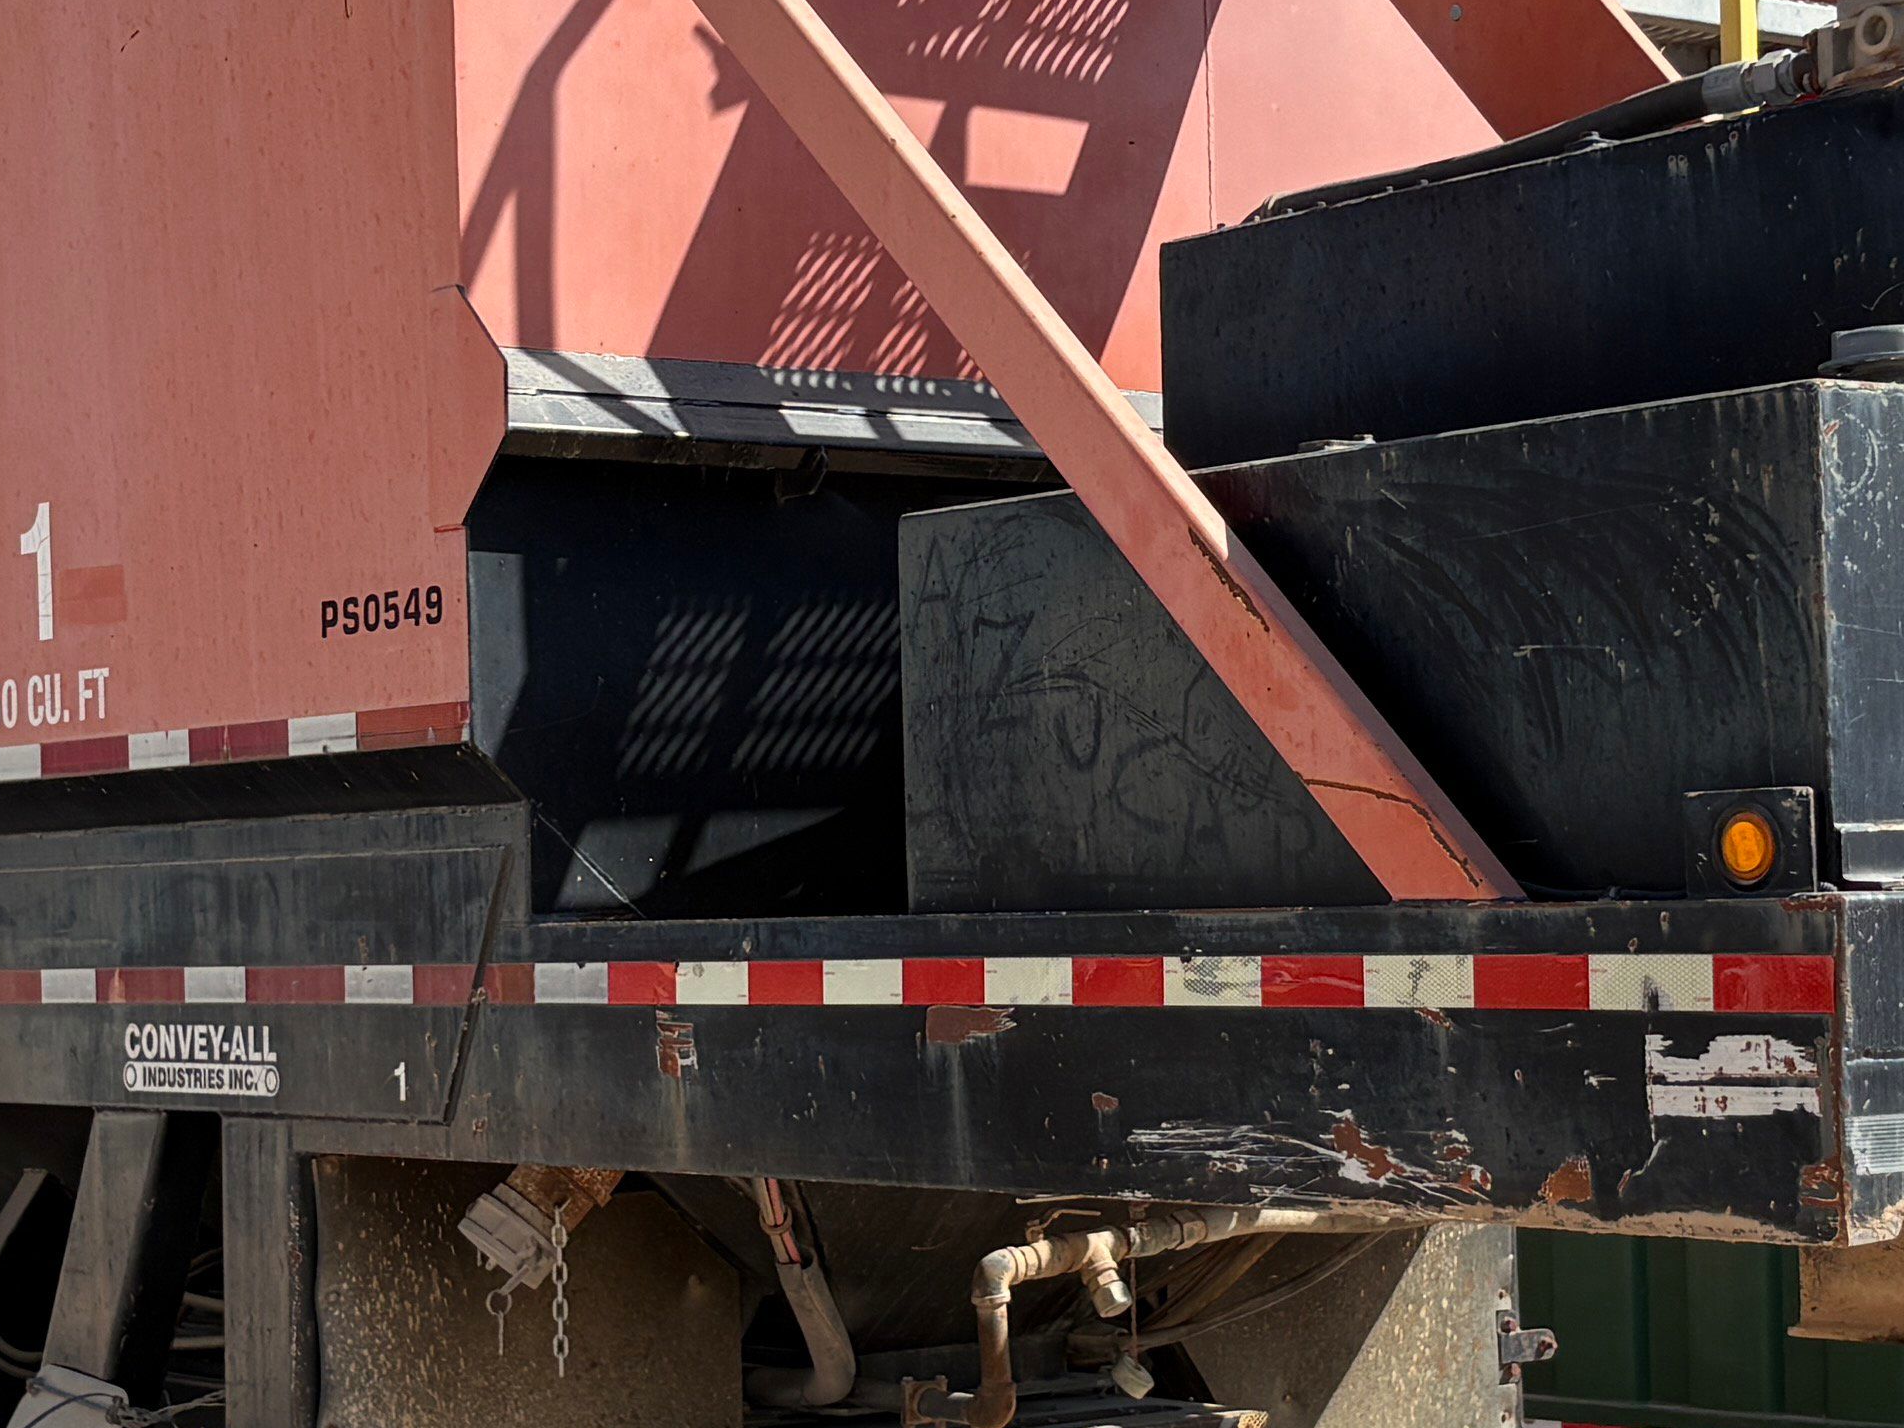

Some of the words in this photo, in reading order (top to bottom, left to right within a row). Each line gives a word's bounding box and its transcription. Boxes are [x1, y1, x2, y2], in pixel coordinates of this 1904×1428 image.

[20, 501, 54, 641] 1
[27, 673, 70, 727] CU.
[78, 667, 109, 722] FT
[124, 1022, 278, 1062] CONVEY-ALL
[142, 1066, 225, 1090] INDUSTRIES
[394, 1062, 406, 1101] 1
